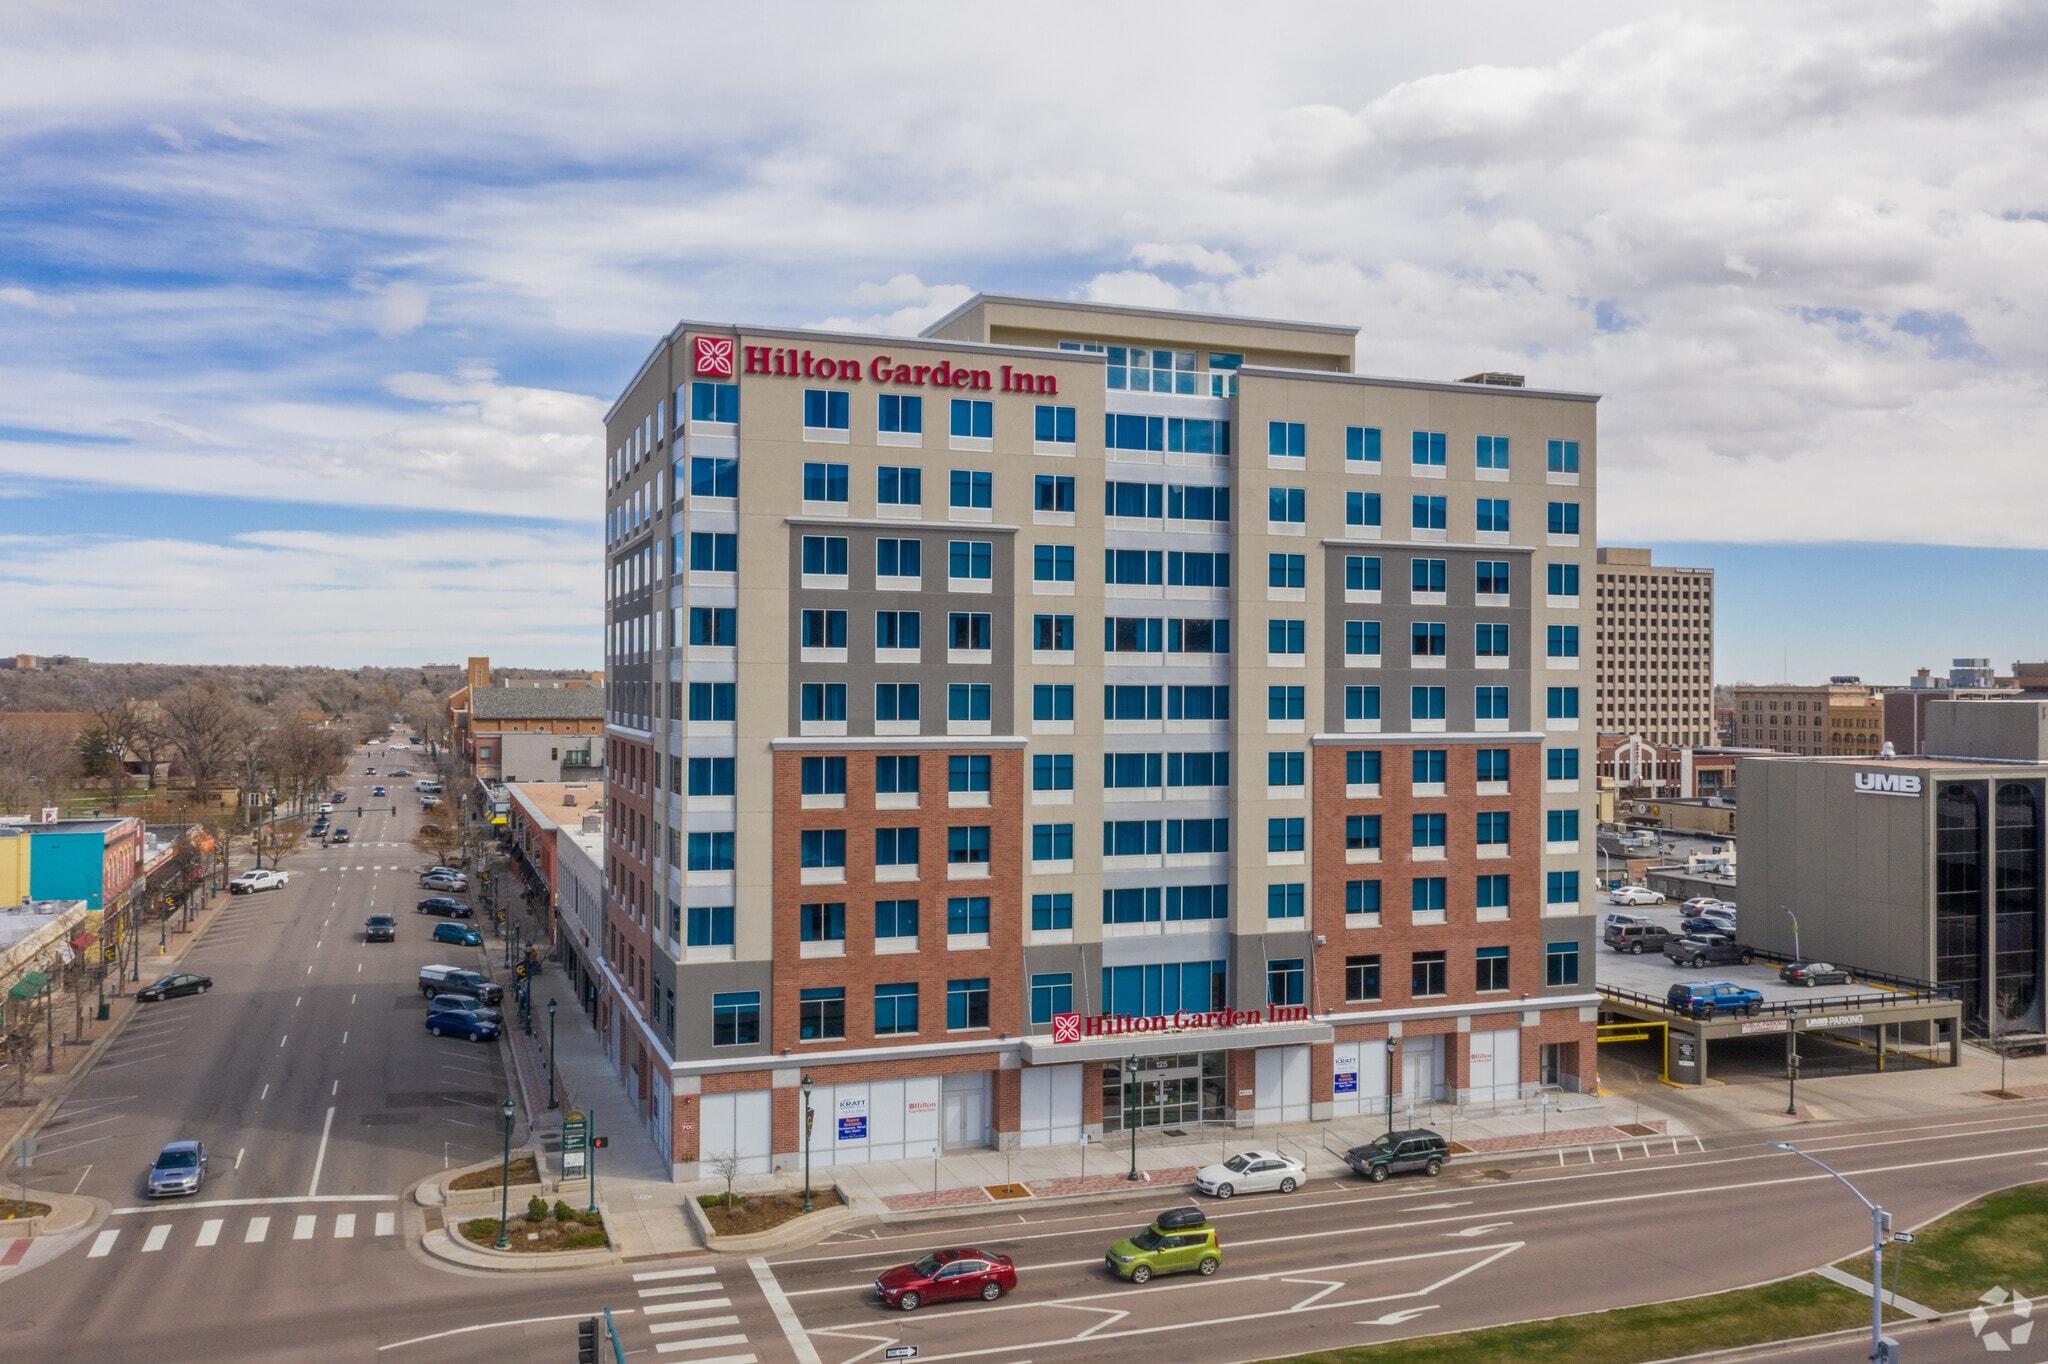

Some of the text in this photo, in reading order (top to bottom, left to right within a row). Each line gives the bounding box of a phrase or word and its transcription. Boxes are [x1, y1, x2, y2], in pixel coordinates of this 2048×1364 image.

[744, 346, 1058, 395] Hilton Garden Inn
[1855, 772, 1921, 793] UMB
[1085, 1003, 1309, 1036] Hilton Garden Inn
[1829, 1014, 1864, 1025] PARKING
[840, 1100, 865, 1108] KRATT
